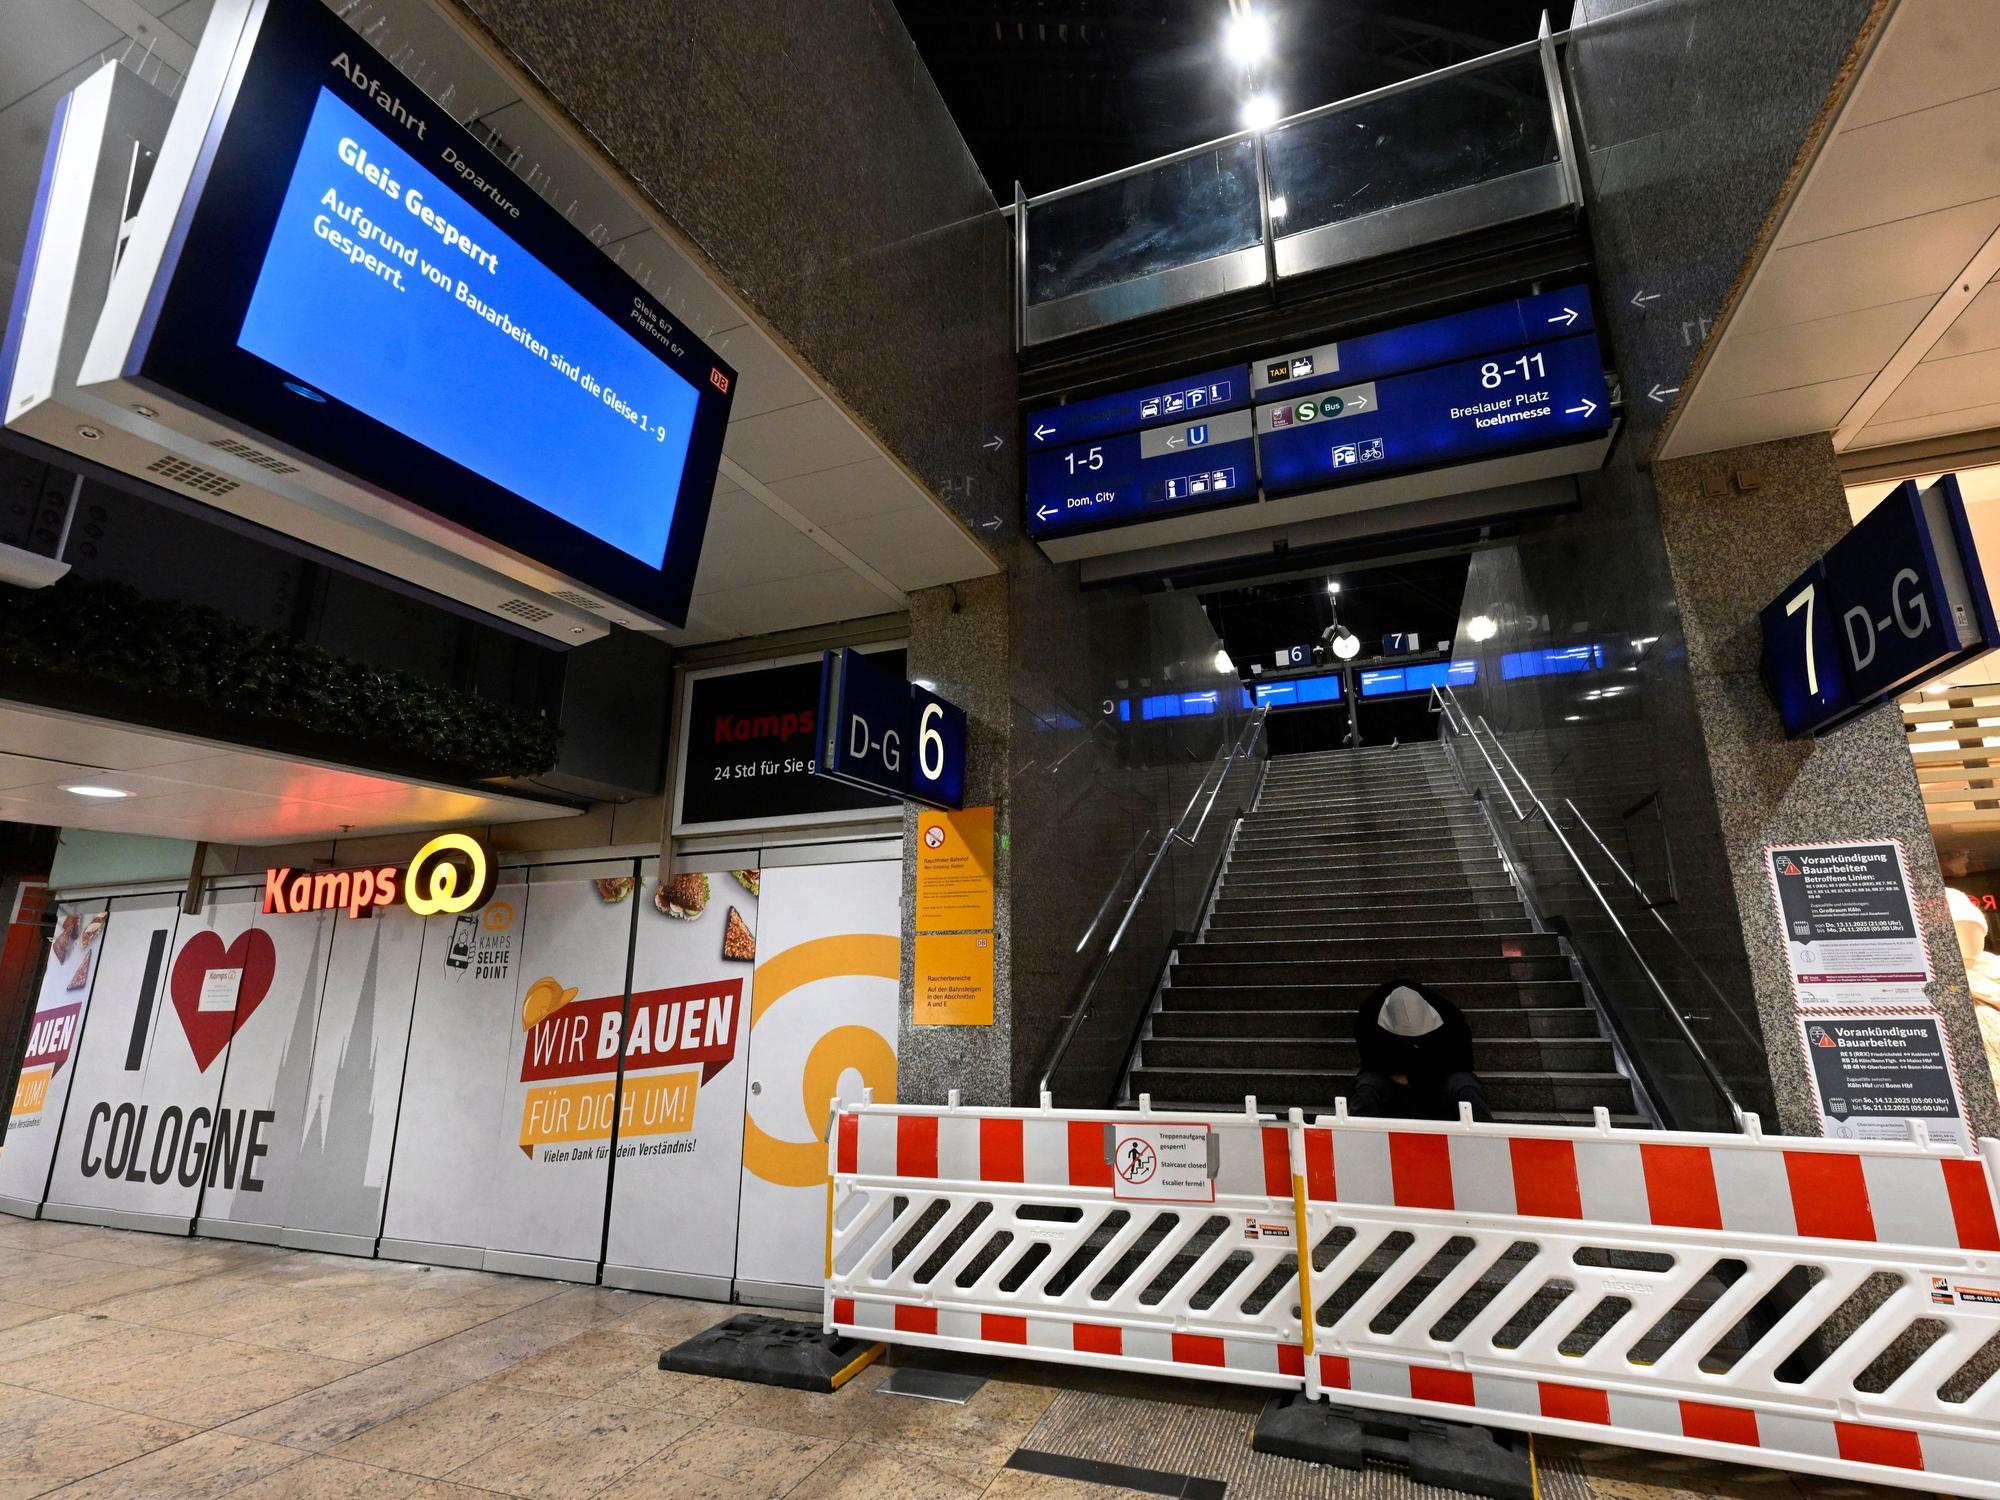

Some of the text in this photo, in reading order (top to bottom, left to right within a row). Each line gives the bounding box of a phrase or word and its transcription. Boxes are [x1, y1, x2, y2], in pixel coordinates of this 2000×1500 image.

[330, 52, 427, 140] Abfahrt
[441, 147, 521, 219] Departure
[338, 137, 499, 275] Gleis Gesperrt
[313, 214, 407, 293] Gesperrt.
[321, 188, 419, 267] Aufgrund
[420, 259, 452, 292] von
[455, 281, 549, 361] Bauarbeiten
[550, 353, 580, 383] sind
[581, 374, 601, 398] die
[603, 388, 638, 424] Gleise
[640, 415, 648, 432] 1
[657, 427, 666, 443] 9
[634, 297, 673, 335] Gleis 6/7
[631, 309, 685, 358] Platform 6/7
[711, 368, 729, 394] DB
[1270, 367, 1287, 377] TAXI
[1481, 352, 1546, 389] 8-11
[1298, 403, 1341, 421] S Bus
[1450, 390, 1550, 419] Breslauer Platz
[1475, 406, 1551, 429] koelnmesse
[1190, 426, 1206, 445] U
[1064, 446, 1104, 475] 1-5
[1067, 490, 1116, 508] Dom, City
[1843, 567, 1933, 672] D-G
[1391, 633, 1402, 649] 7
[1785, 583, 1819, 696] 7
[1291, 646, 1302, 662] 6
[714, 709, 816, 743] Kamps
[850, 713, 900, 773] D-G
[918, 702, 944, 781] 6
[714, 765, 731, 781] 24
[735, 762, 756, 779] Std
[760, 760, 780, 776] für
[784, 758, 803, 773] Sie
[1800, 853, 1887, 865] Vorankündigung
[1802, 864, 1867, 875] Bauarbeiten
[1804, 875, 1847, 883] Betroffene
[262, 866, 398, 919] Kamps
[480, 935, 512, 949] KAMPS
[477, 950, 510, 964] SELFIE
[475, 966, 508, 980] POINT
[124, 929, 168, 1071] I
[25, 1014, 76, 1058] AUEN
[533, 995, 734, 1068] WIR BAUEN
[1835, 1026, 1928, 1038] Vorankündigung
[1838, 1038, 1907, 1047] Bauarbeiten
[529, 1085, 688, 1135] FÜR DICH UM!
[1933, 1097, 1949, 1105] Uhr)
[1933, 1105, 1949, 1113] Uhr)
[80, 1101, 275, 1193] COLOGNE
[1160, 1133, 1206, 1141] Treppenaufgang
[543, 1138, 697, 1163] Vielen Dank für dein Verständnis!
[1600, 1275, 1653, 1295] nissen
